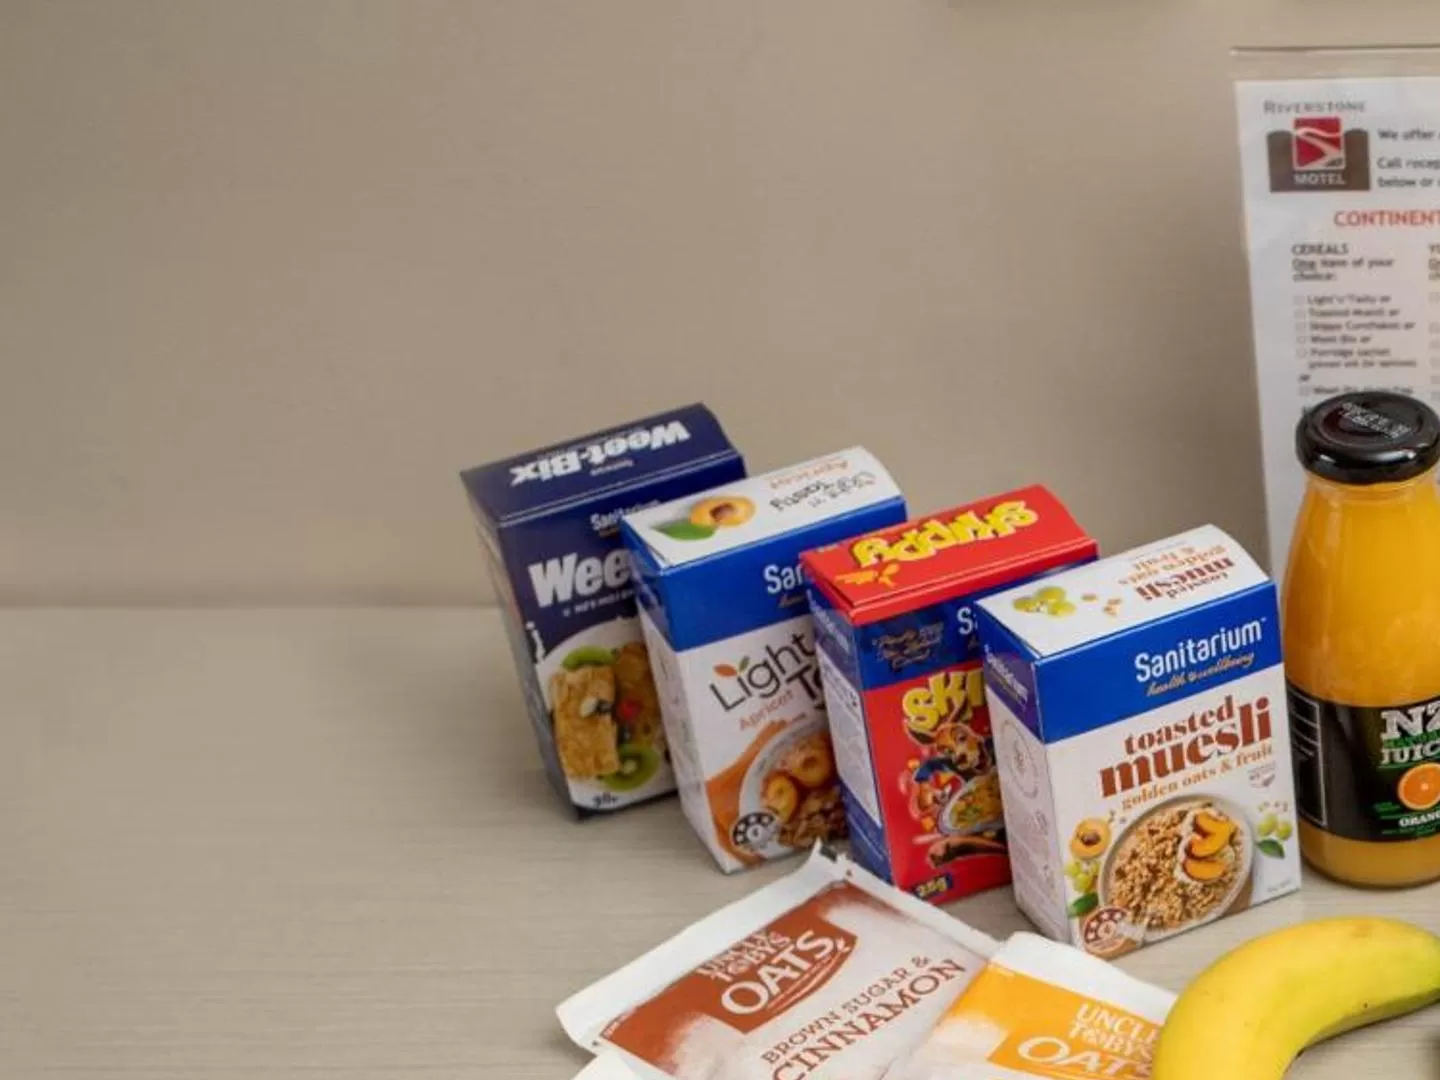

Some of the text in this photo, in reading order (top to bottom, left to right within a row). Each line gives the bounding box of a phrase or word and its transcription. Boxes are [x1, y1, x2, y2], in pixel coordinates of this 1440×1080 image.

[1377, 157, 1401, 169] Call
[1378, 129, 1398, 140] We
[1403, 129, 1434, 140] offer
[1294, 172, 1346, 185] MOTEL
[1378, 176, 1416, 188] below
[1420, 178, 1433, 188] or
[1291, 242, 1349, 255] CEREALS
[1292, 258, 1316, 270] One
[1368, 258, 1394, 269] your
[510, 420, 691, 486] Weet-Bix
[528, 549, 634, 608] Wee
[709, 632, 816, 712] Light
[1134, 619, 1262, 683] Sanitarium
[1099, 696, 1272, 797] muesli
[1123, 695, 1237, 755] toasted
[1122, 745, 1273, 811] golden oats & fruit
[720, 929, 836, 1016] OATS
[761, 954, 932, 1067] BROWN SUGAR &
